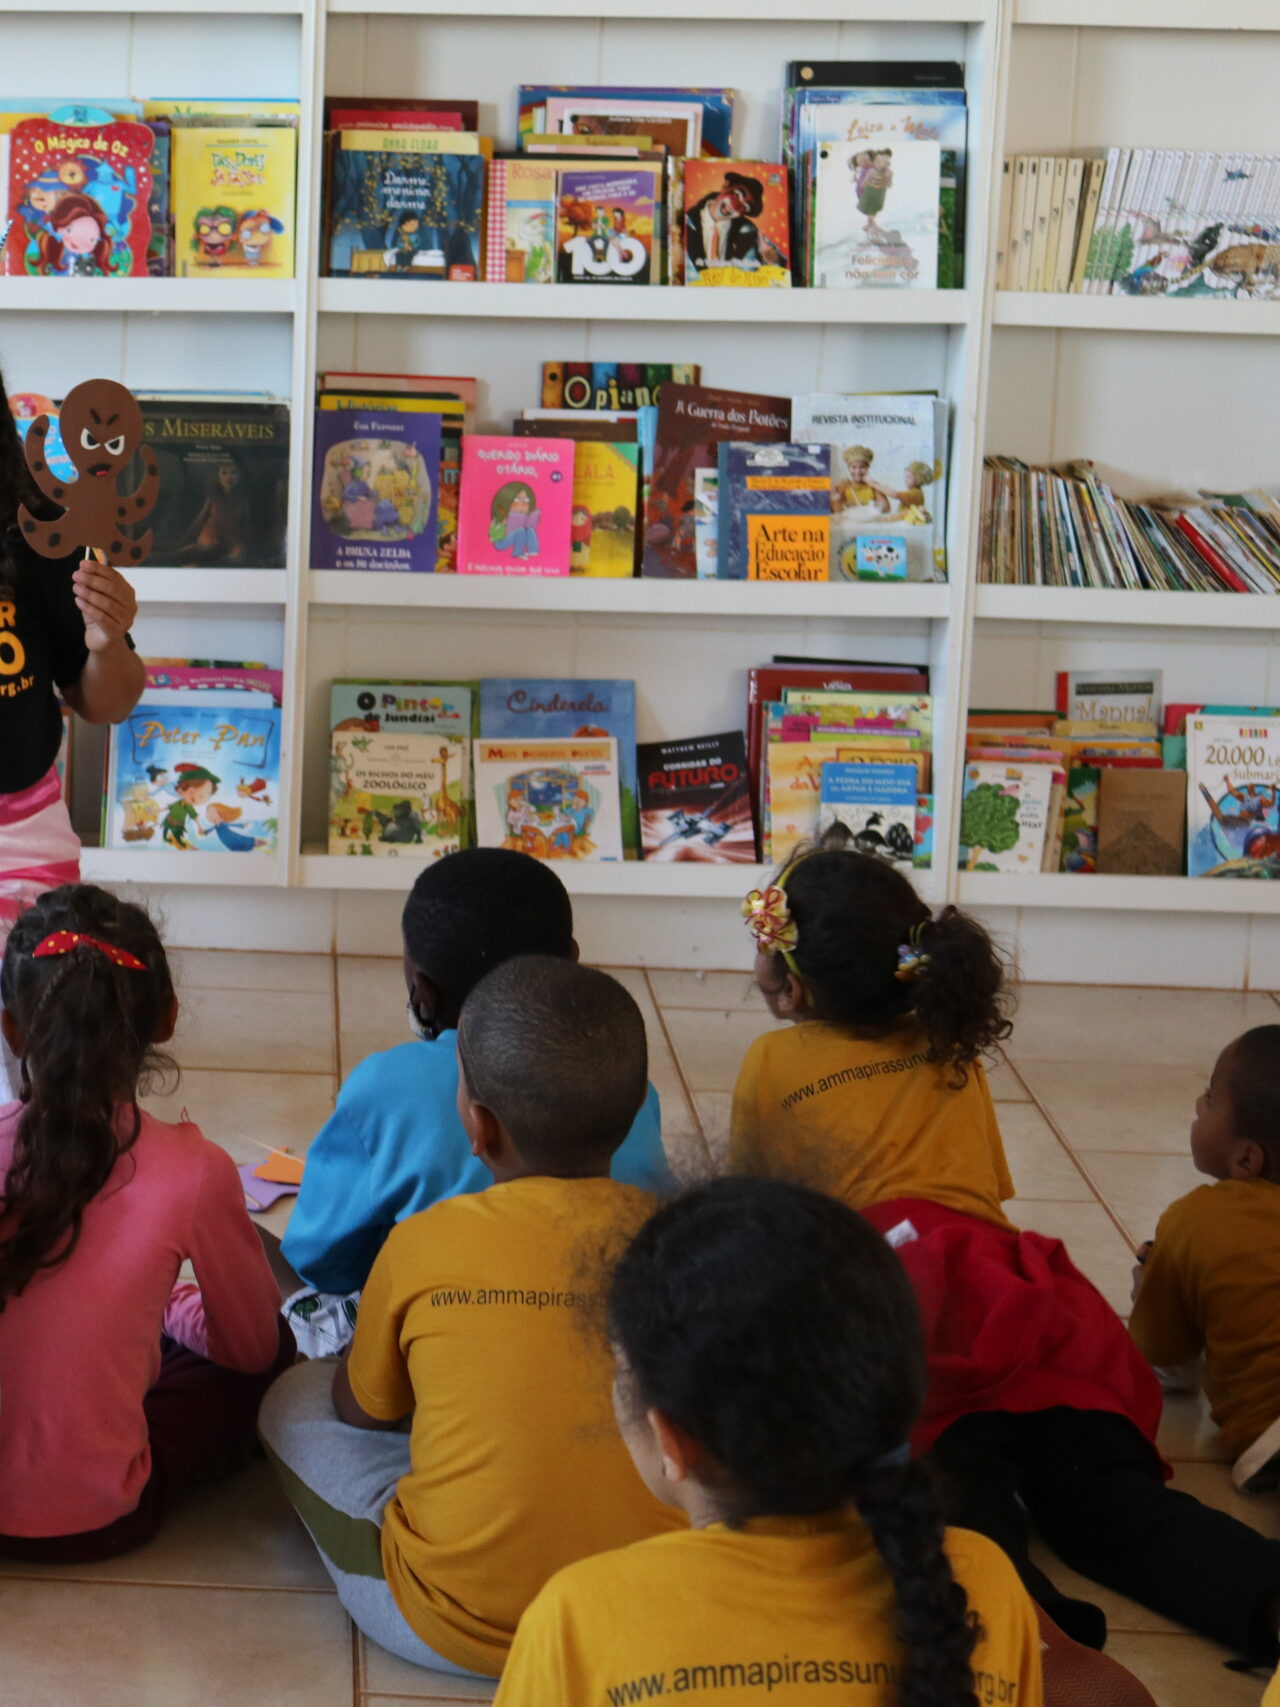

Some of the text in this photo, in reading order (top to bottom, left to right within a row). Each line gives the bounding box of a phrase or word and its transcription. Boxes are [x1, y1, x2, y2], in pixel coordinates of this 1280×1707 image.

[35, 133, 130, 158] O Mágico de Oz
[675, 400, 789, 429] A Guerra dos Botões
[812, 415, 918, 426] REVISTA INSTITUCIONAL
[162, 418, 275, 438] MISERÁVEIS
[758, 524, 825, 542] Arte na
[755, 541, 826, 564] Educação
[755, 562, 823, 580] Escolar
[357, 691, 376, 711] O
[506, 689, 609, 714] Cinderela
[1076, 697, 1154, 722] Manual
[365, 713, 381, 723] de
[135, 721, 266, 751] Peter Pan
[708, 757, 723, 766] DO
[1205, 744, 1266, 766] 20.000
[355, 770, 435, 780] OS BICHOS DO MEU
[363, 779, 428, 791] ZOOLÓGICO
[648, 763, 739, 791] FUTURO
[779, 1054, 930, 1112] www.ammapirassun
[431, 1287, 606, 1310] www.ammapirass
